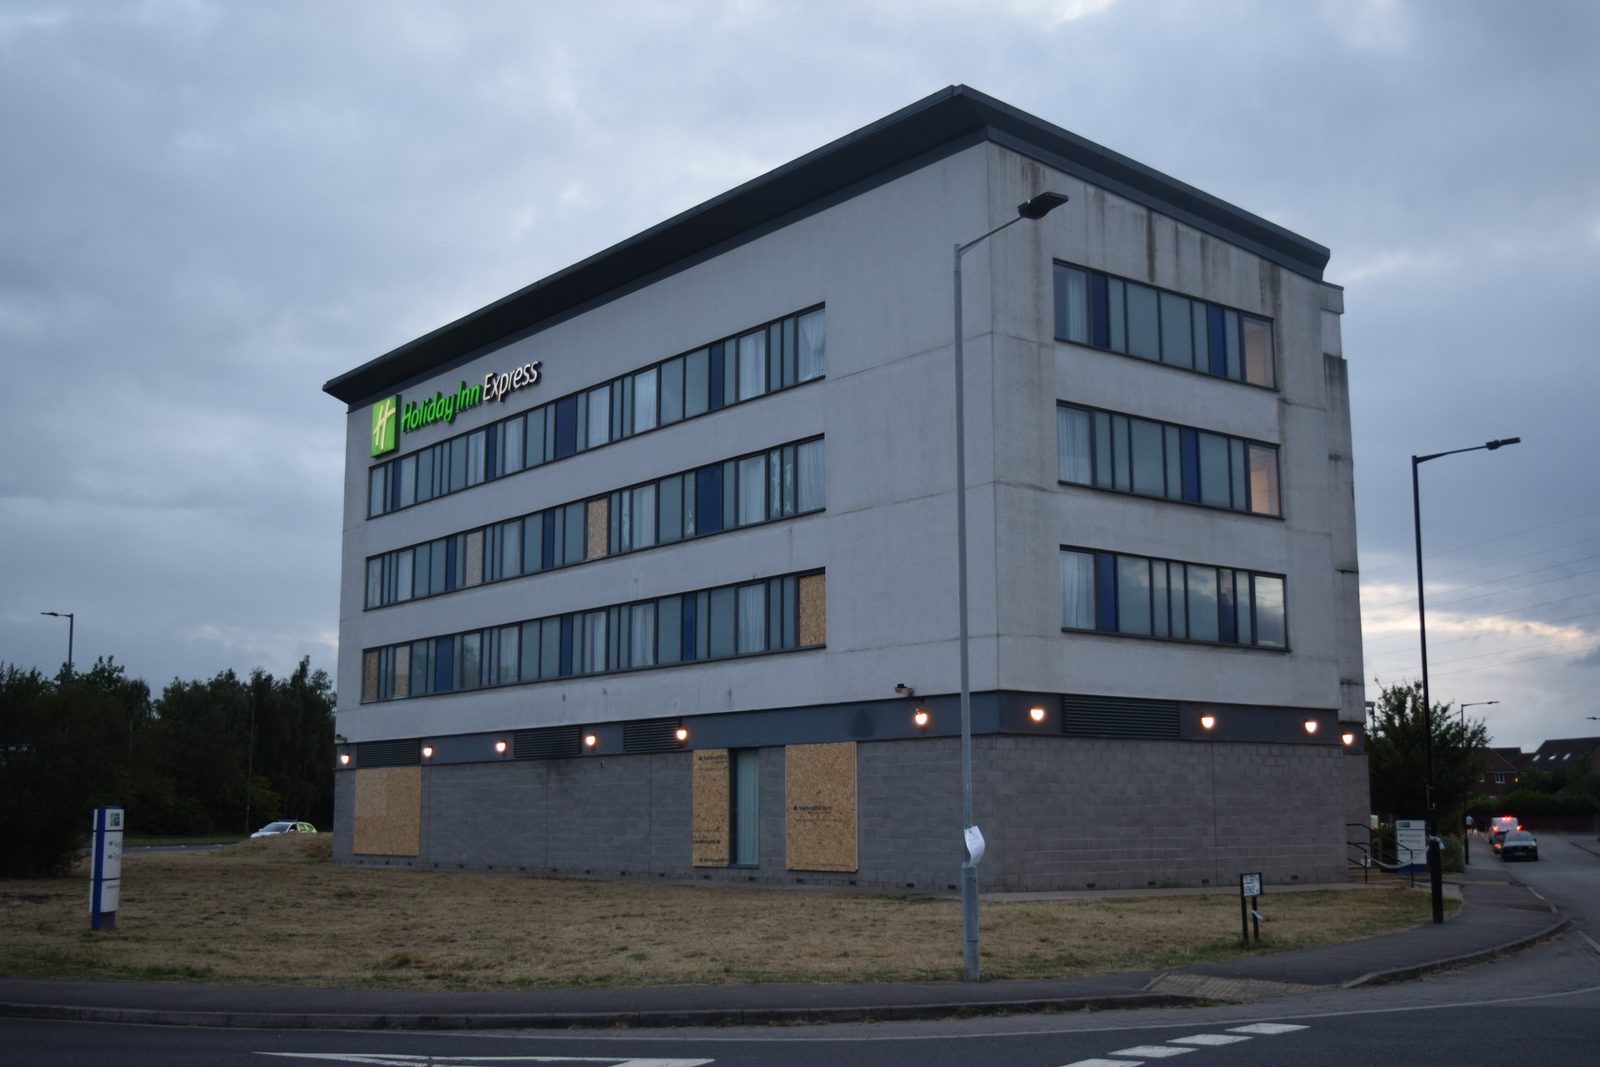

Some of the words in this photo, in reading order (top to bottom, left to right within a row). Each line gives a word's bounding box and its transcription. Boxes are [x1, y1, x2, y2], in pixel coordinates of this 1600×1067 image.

[401, 391, 457, 433] Holiday
[456, 380, 482, 412] Inn
[483, 360, 540, 402] Express
